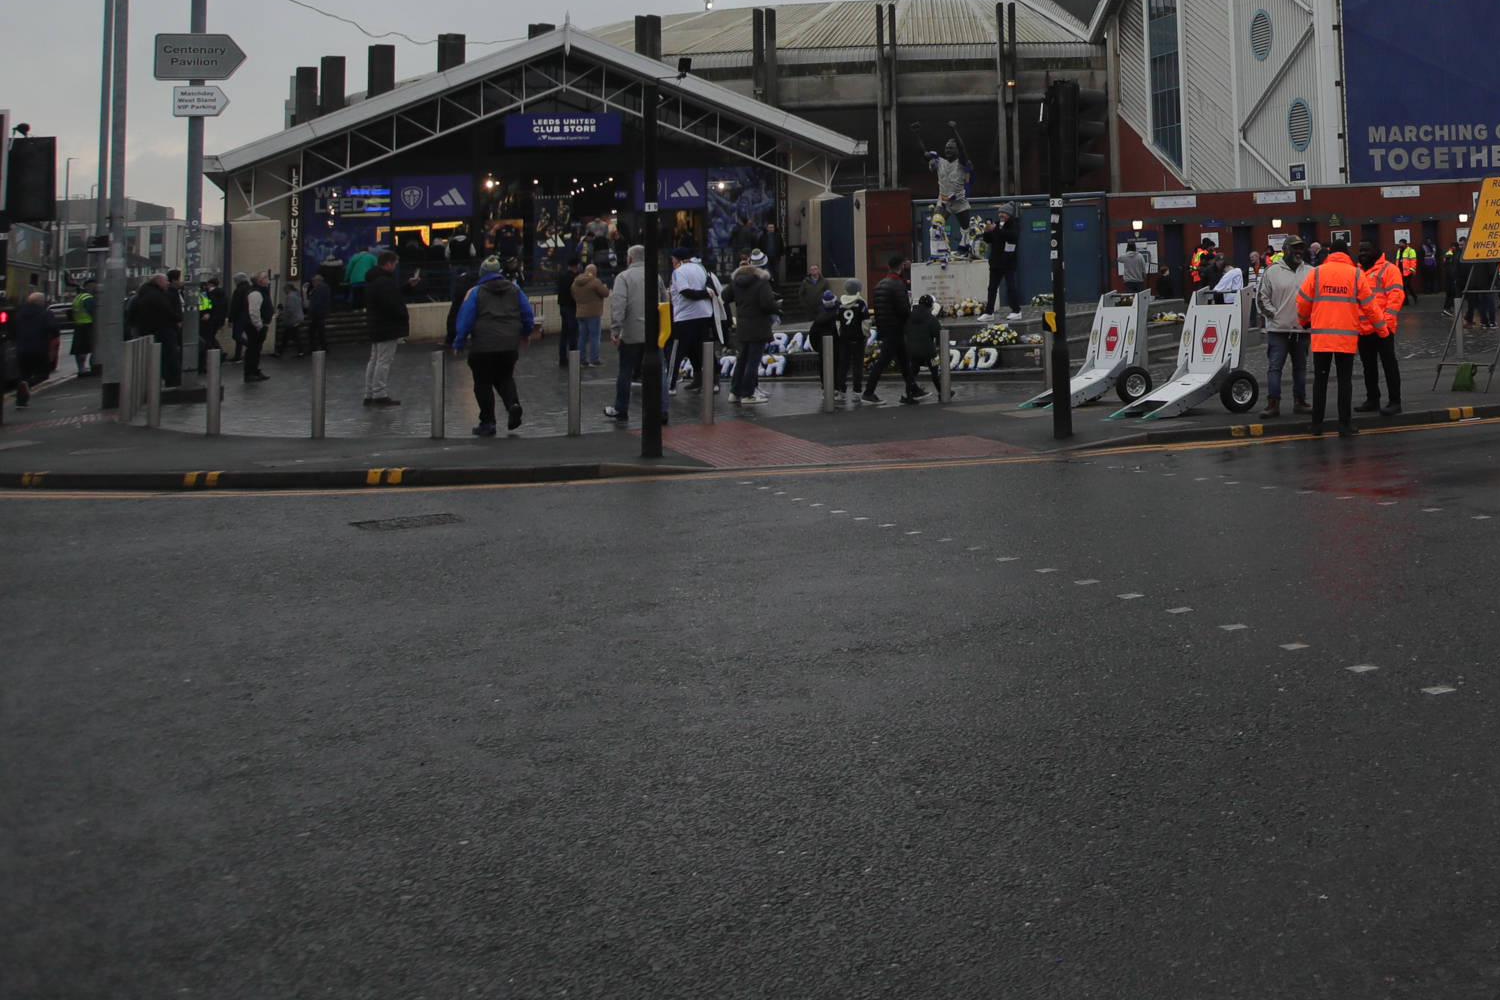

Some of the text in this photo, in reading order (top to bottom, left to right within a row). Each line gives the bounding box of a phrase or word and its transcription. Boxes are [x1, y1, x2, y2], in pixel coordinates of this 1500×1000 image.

[163, 45, 226, 55] Centenary
[171, 57, 218, 66] Pavilion
[533, 125, 596, 133] CLUB STORE
[1368, 124, 1488, 143] MARCHING
[314, 186, 342, 198] WE
[314, 198, 383, 214] LEEDS
[1482, 222, 1499, 231] AND
[291, 219, 299, 277] UNITED
[1473, 240, 1496, 249] WHEN
[1486, 249, 1499, 257] DO
[843, 310, 855, 325] 9
